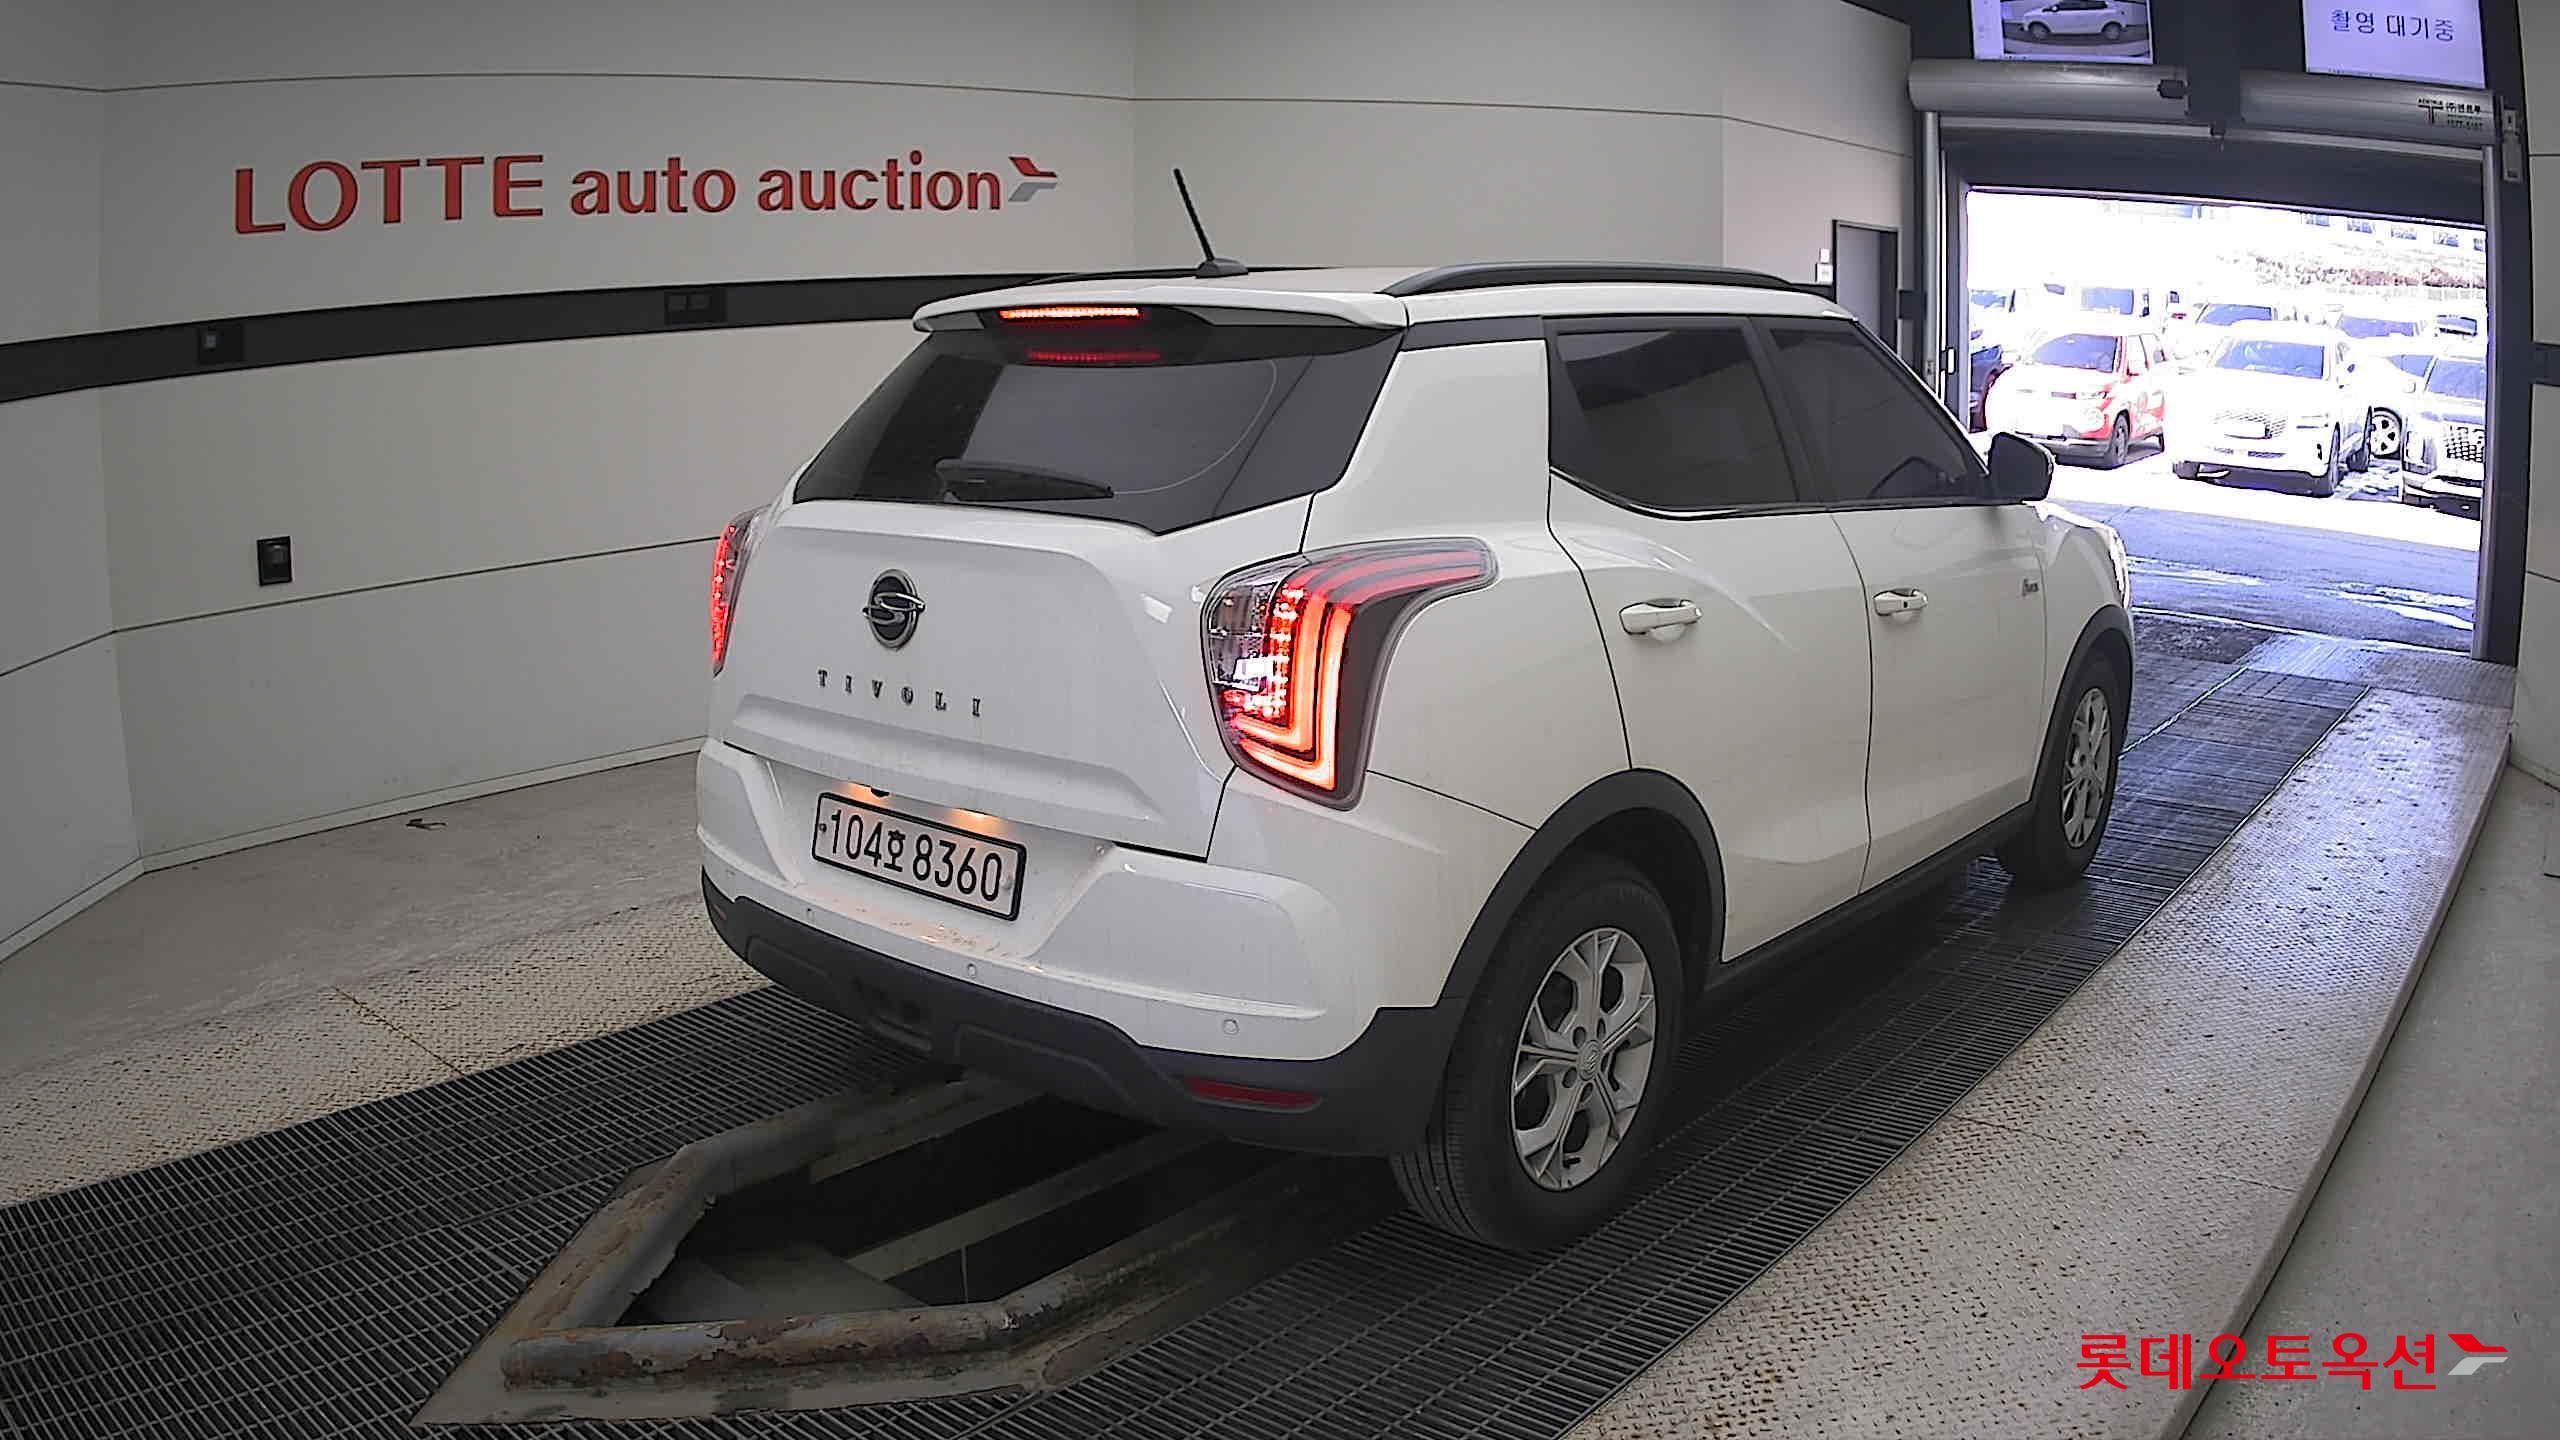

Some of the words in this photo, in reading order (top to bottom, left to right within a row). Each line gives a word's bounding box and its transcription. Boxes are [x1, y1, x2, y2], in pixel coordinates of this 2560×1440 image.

[2331, 10, 2375, 34] 촬영
[2386, 15, 2454, 42] 대기중
[236, 155, 543, 234] LOTTE
[571, 156, 737, 216] auto
[757, 151, 1003, 213] auction
[817, 669, 981, 718] TIVOLI
